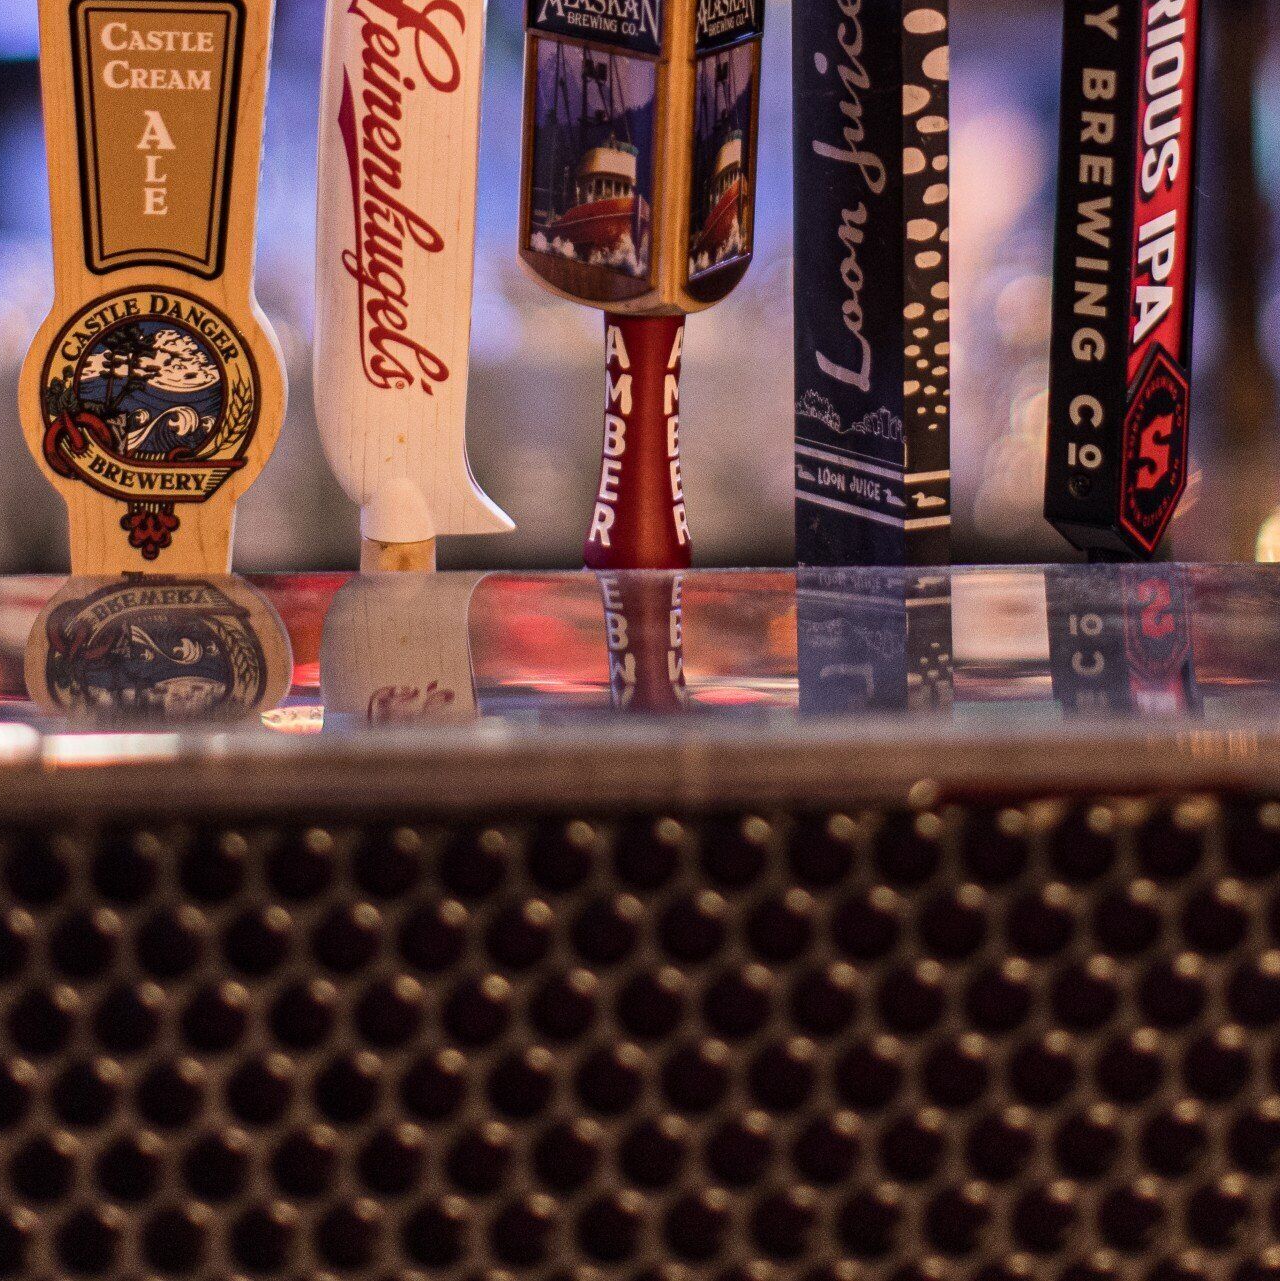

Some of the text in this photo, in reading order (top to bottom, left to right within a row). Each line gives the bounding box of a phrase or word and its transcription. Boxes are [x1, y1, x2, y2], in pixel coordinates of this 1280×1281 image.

[567, 11, 618, 34] BREWING
[137, 110, 176, 216] ALE
[1070, 67, 1117, 363] BREWING
[61, 294, 240, 364] CASTLE DANGER
[816, 201, 871, 393] Loon
[1133, 209, 1178, 343] IPA
[88, 452, 206, 492] BREWERY
[589, 325, 633, 546] AMBER
[817, 467, 881, 502] LOON JUICE
